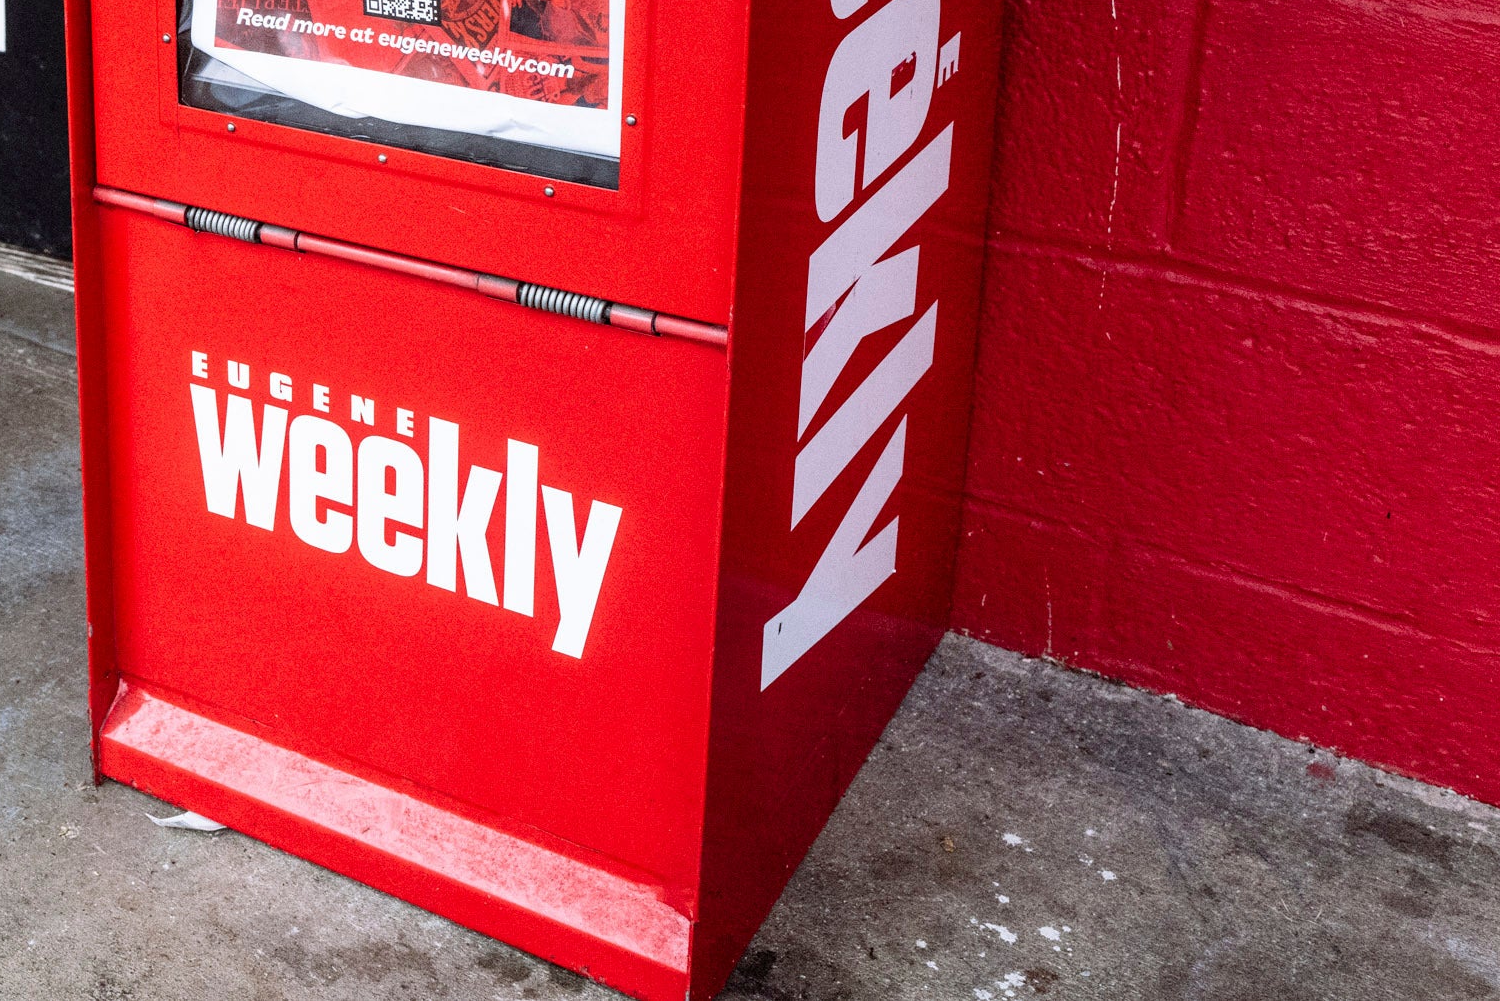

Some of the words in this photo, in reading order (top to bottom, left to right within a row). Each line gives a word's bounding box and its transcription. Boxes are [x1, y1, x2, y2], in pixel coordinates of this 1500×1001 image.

[236, 7, 289, 31] Read
[292, 18, 347, 41] more
[349, 25, 374, 45] at
[378, 32, 576, 79] eugeneweekly.com
[191, 350, 415, 438] EUGENE
